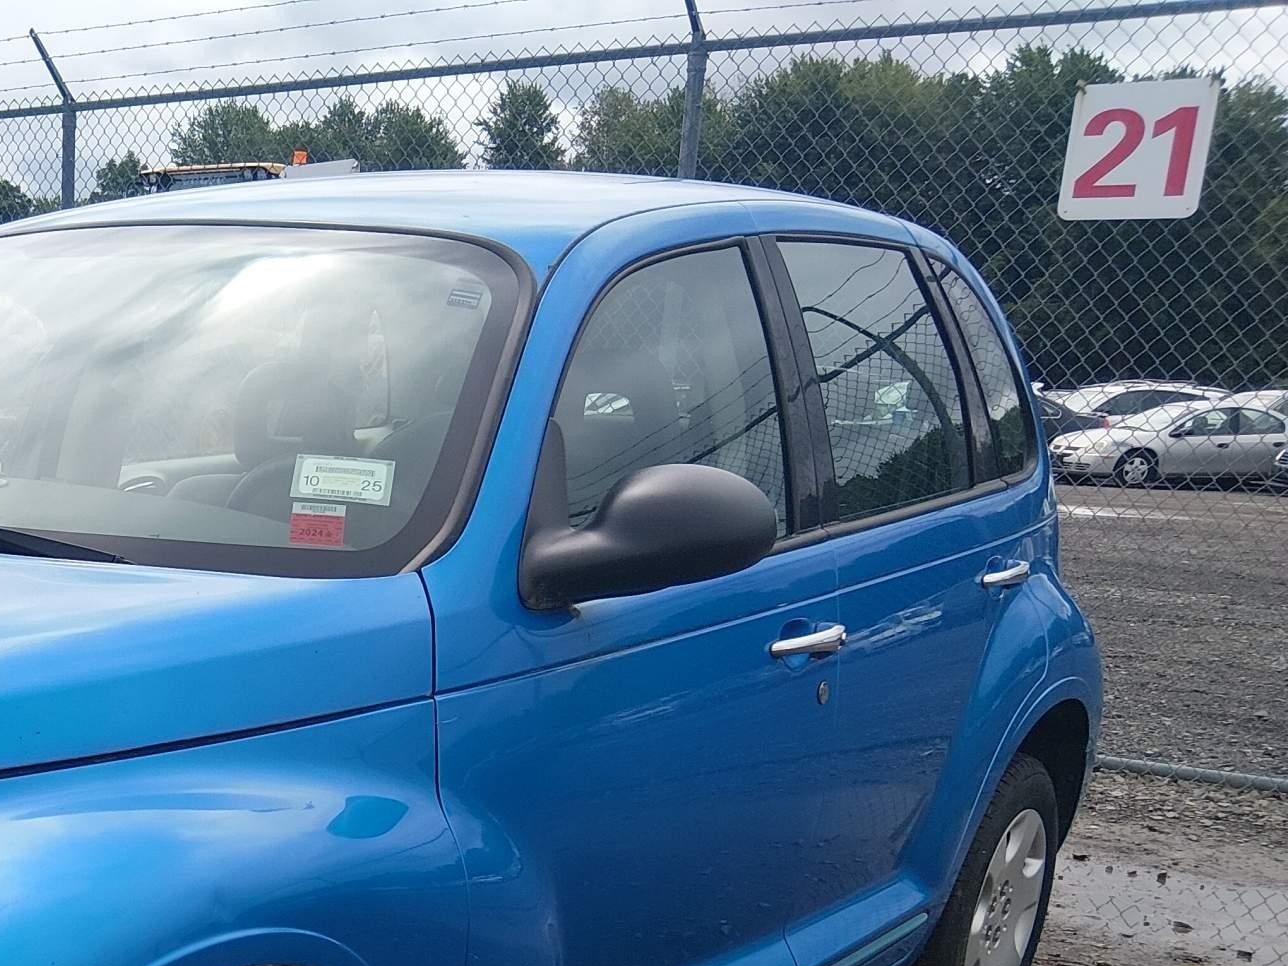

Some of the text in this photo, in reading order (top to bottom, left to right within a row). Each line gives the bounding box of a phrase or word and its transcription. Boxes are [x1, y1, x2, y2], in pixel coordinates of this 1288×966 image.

[1072, 106, 1199, 198] 21
[303, 475, 383, 492] 10 25
[299, 528, 324, 537] 2024
